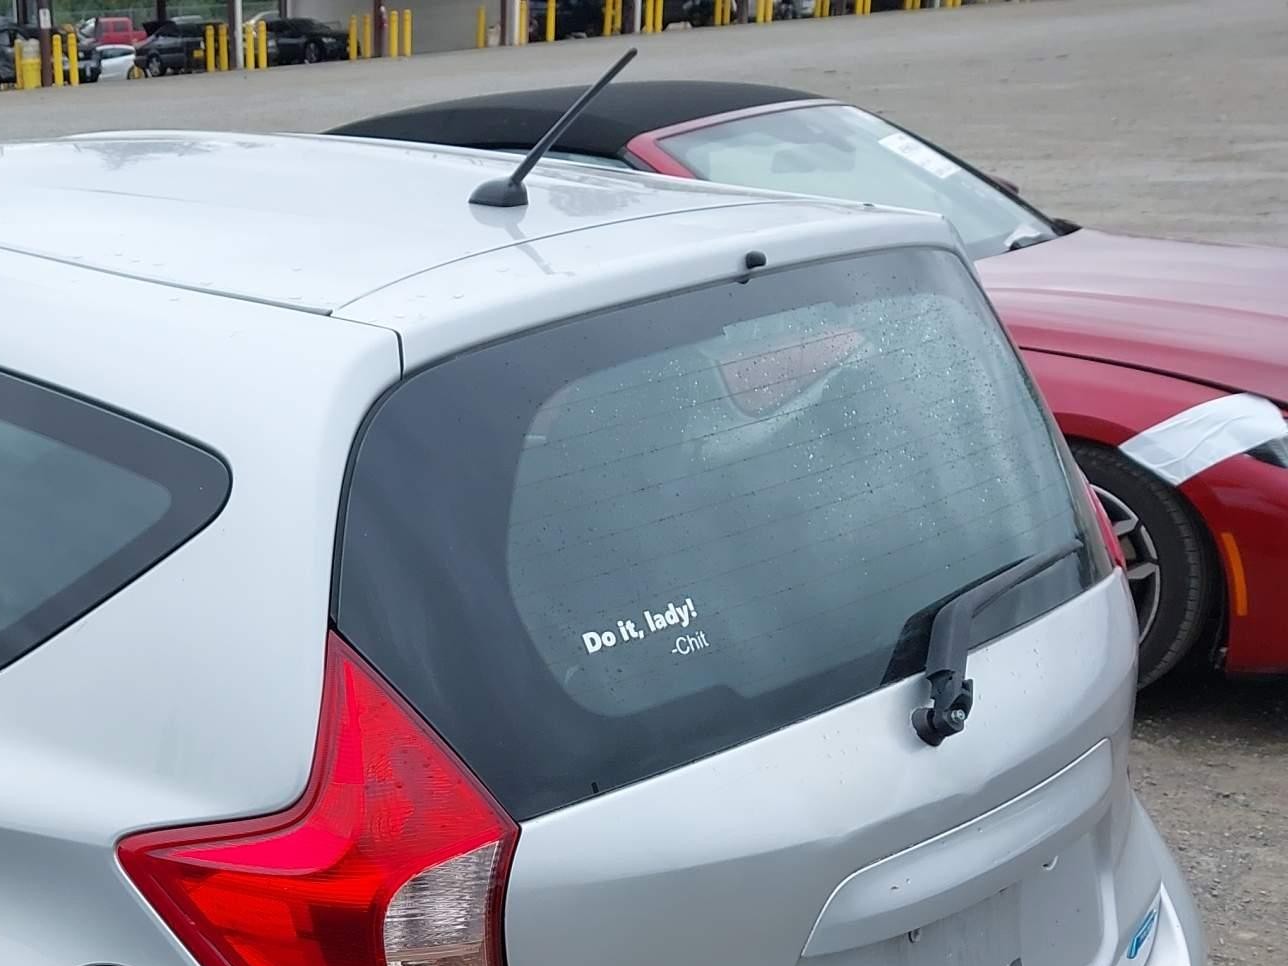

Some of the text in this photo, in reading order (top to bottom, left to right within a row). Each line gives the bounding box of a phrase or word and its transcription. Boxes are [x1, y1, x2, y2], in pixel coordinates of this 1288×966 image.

[581, 597, 698, 654] Do it, lady!
[671, 630, 710, 655] -Chit
